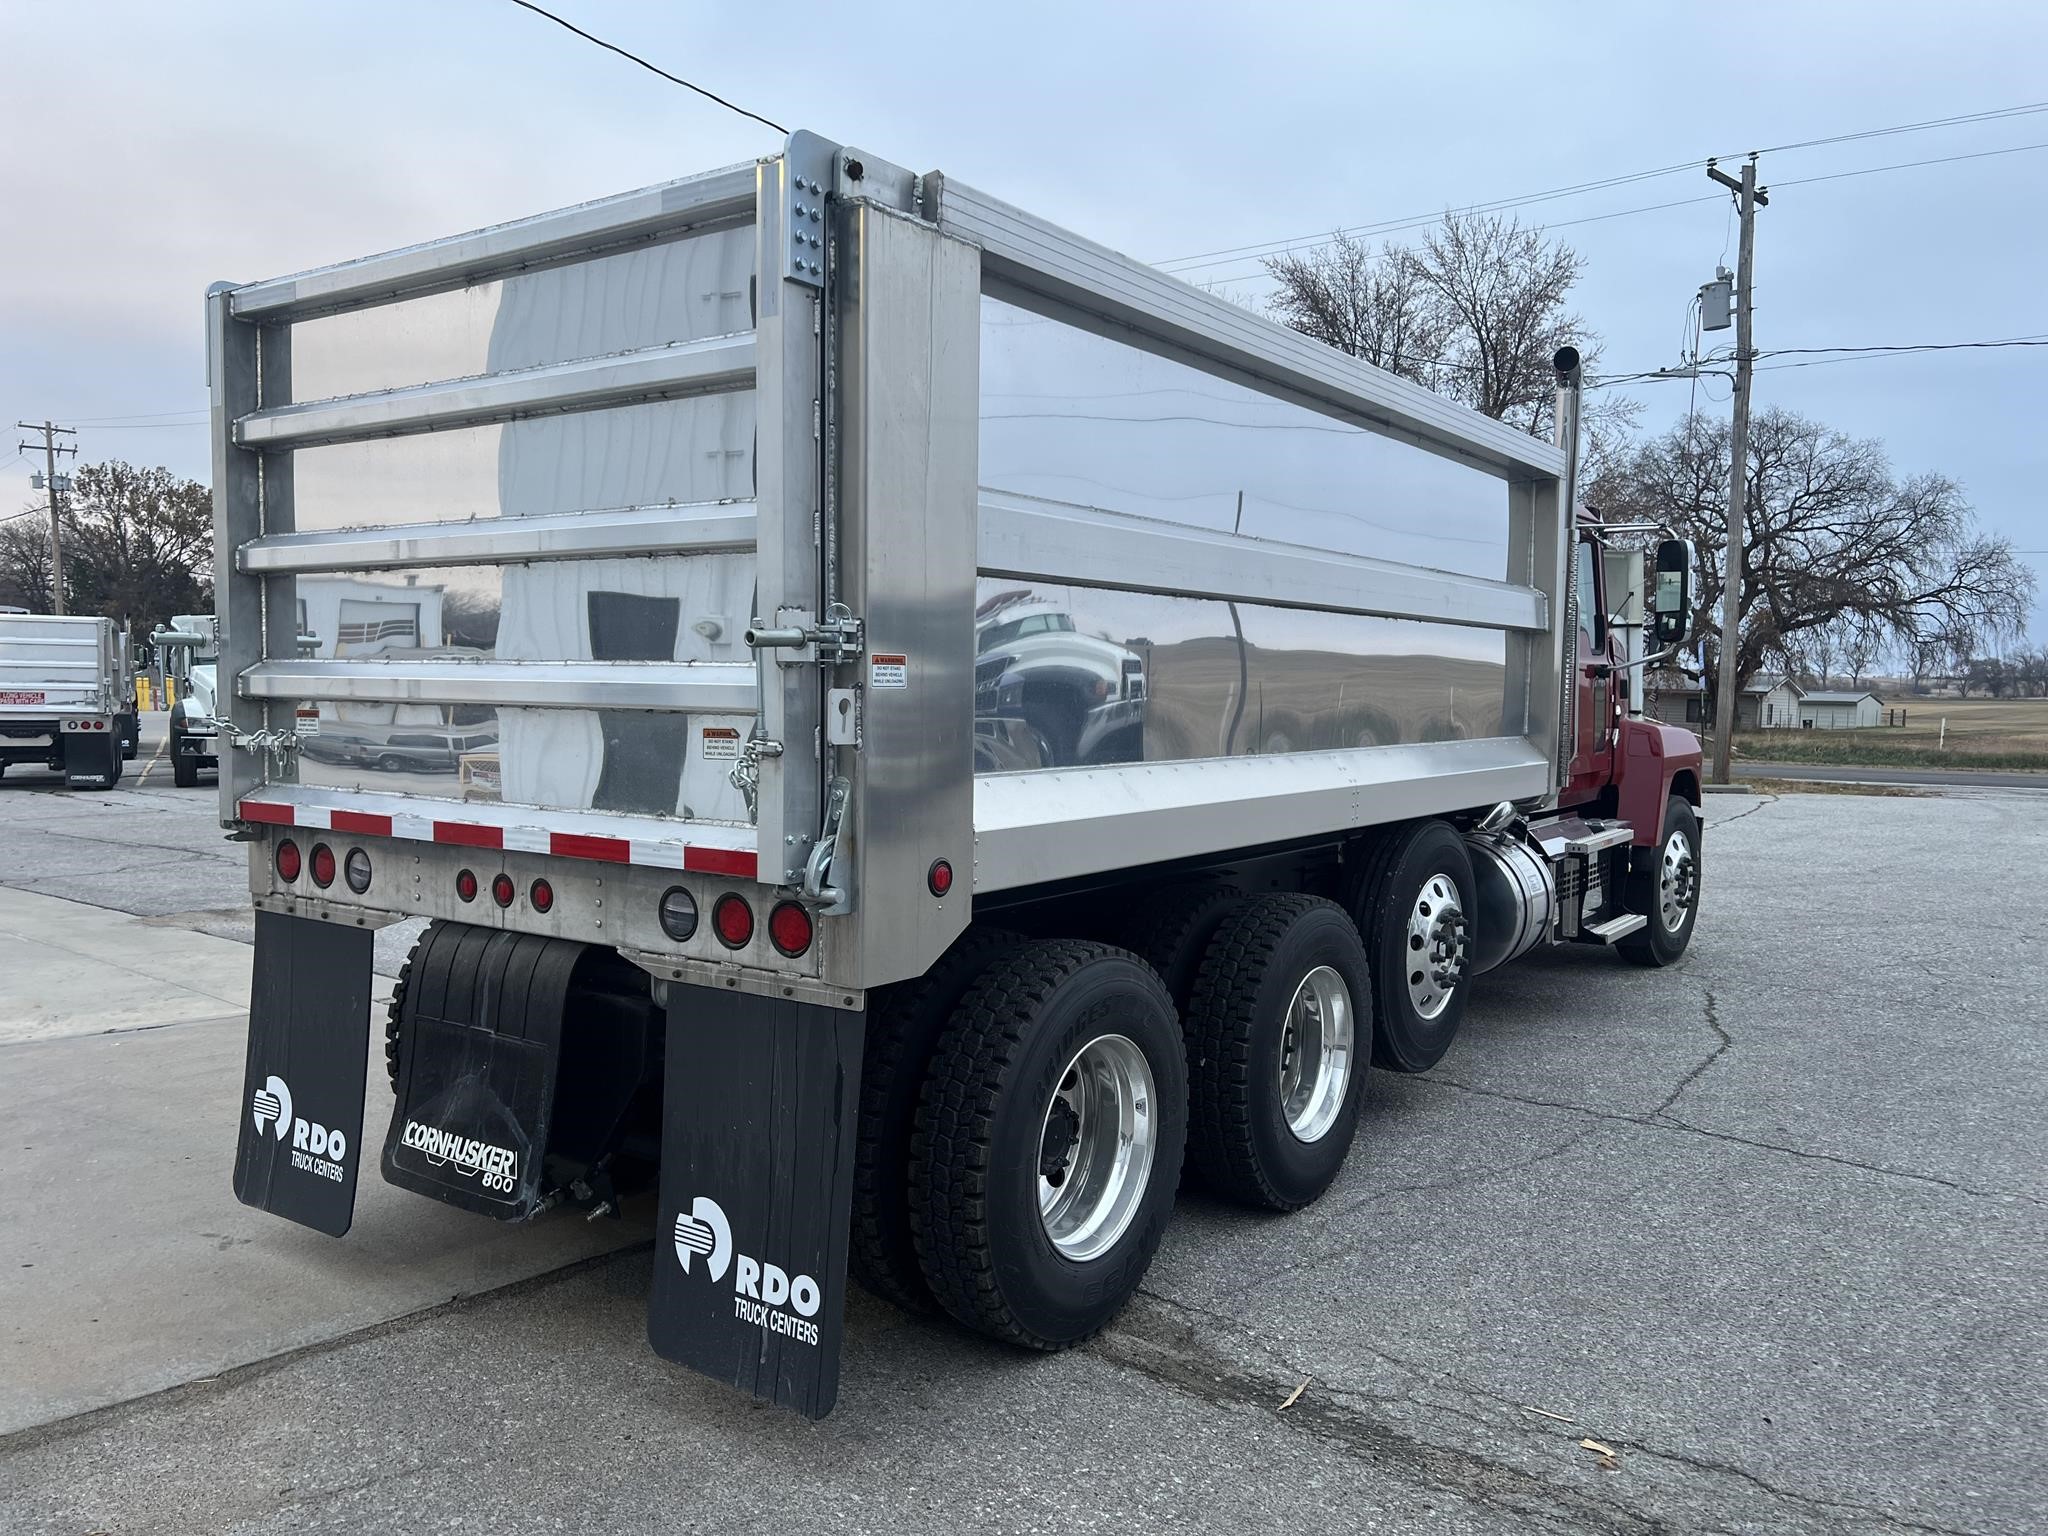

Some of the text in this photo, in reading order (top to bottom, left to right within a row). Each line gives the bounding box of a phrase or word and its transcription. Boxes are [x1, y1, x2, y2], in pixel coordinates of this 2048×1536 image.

[292, 1117, 346, 1162] RDO
[404, 1121, 515, 1176] CORNHUSKER
[291, 1150, 344, 1183] TRUCK CENTERS
[481, 1171, 514, 1194] 800
[735, 1253, 821, 1317] RDO
[734, 1296, 819, 1347] TRUCK CENTERS
